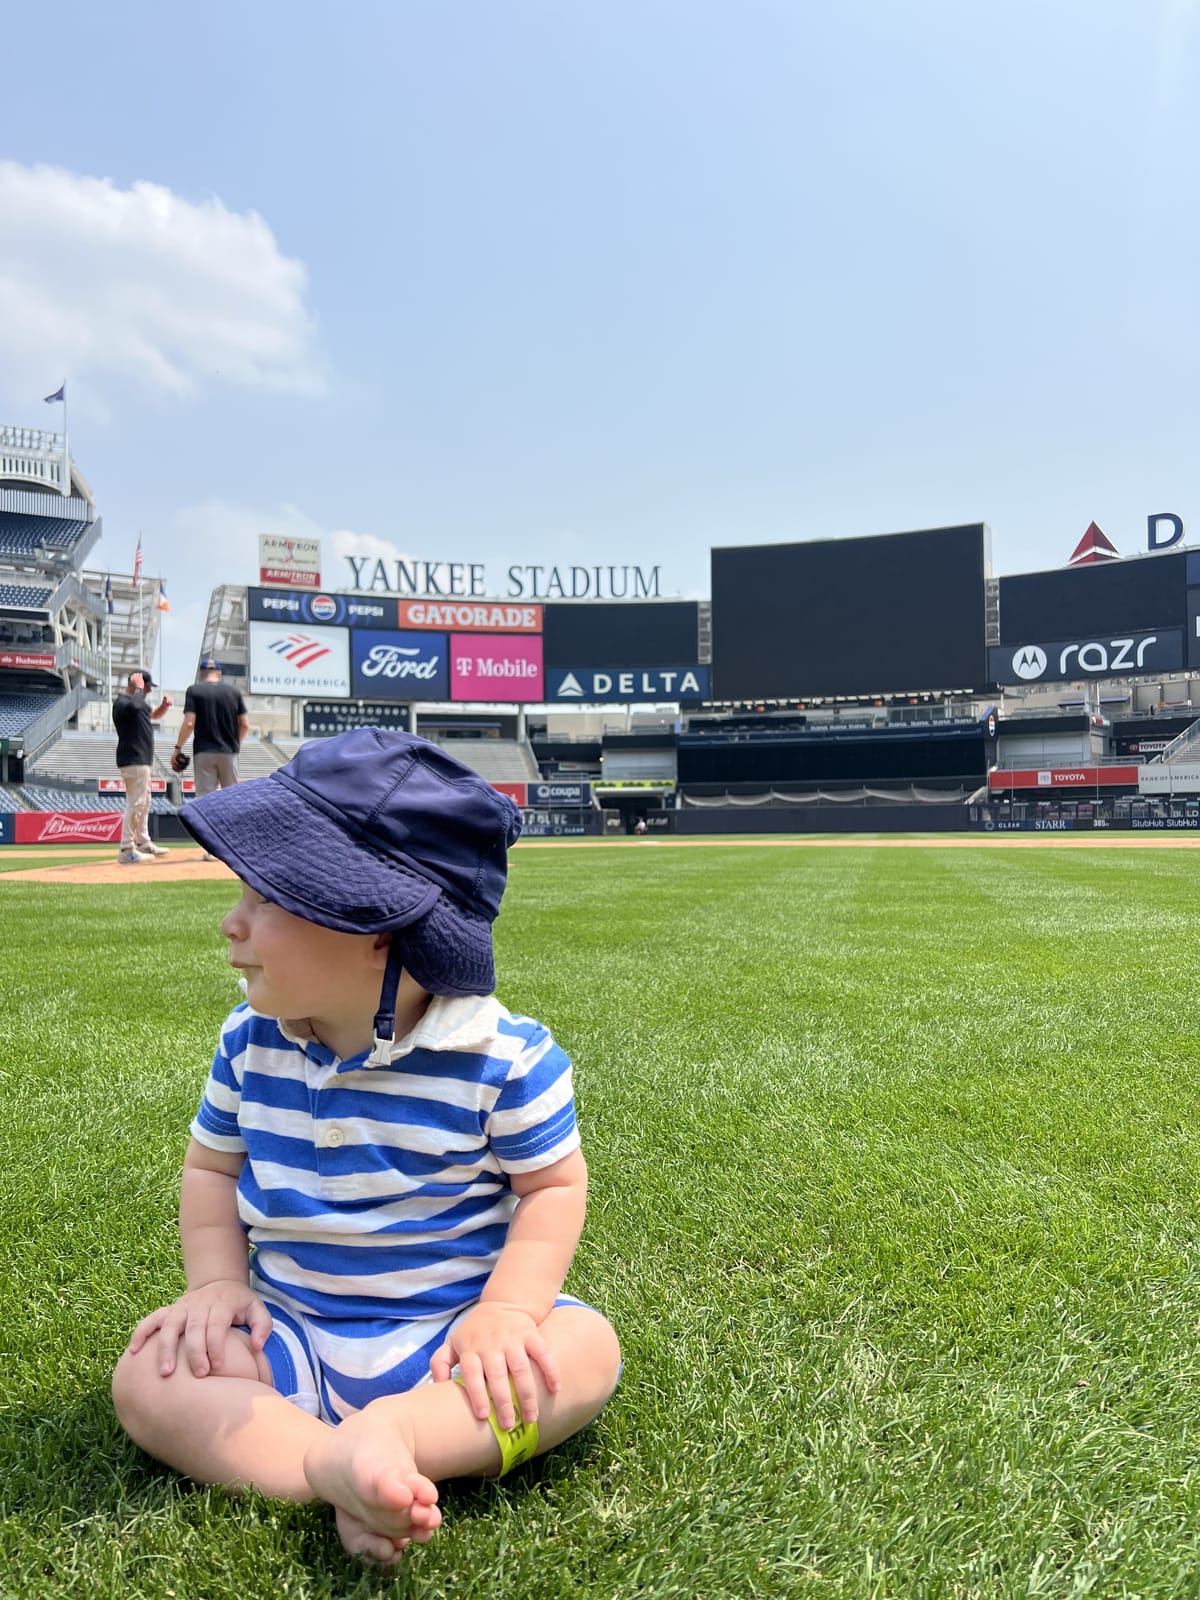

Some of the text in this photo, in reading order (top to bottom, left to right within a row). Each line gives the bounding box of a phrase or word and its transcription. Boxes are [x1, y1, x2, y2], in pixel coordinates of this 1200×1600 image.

[344, 556, 662, 599] YANKEE STADIUM
[262, 597, 299, 611] PEPSI
[347, 604, 384, 617] PEPSI
[407, 603, 536, 628] GATORADE
[361, 644, 439, 680] Ford
[1060, 636, 1157, 675] razr
[477, 657, 538, 678] Mobile
[252, 675, 347, 688] BANK OF AMERICA
[593, 671, 700, 694] DELTA
[1054, 773, 1085, 782] TOYOTA
[1169, 773, 1200, 781] AMERICA
[551, 786, 580, 798] coupa
[48, 820, 117, 834] Budweiser
[1035, 819, 1066, 830] STARR
[1131, 818, 1198, 828] StubHub StubHub
